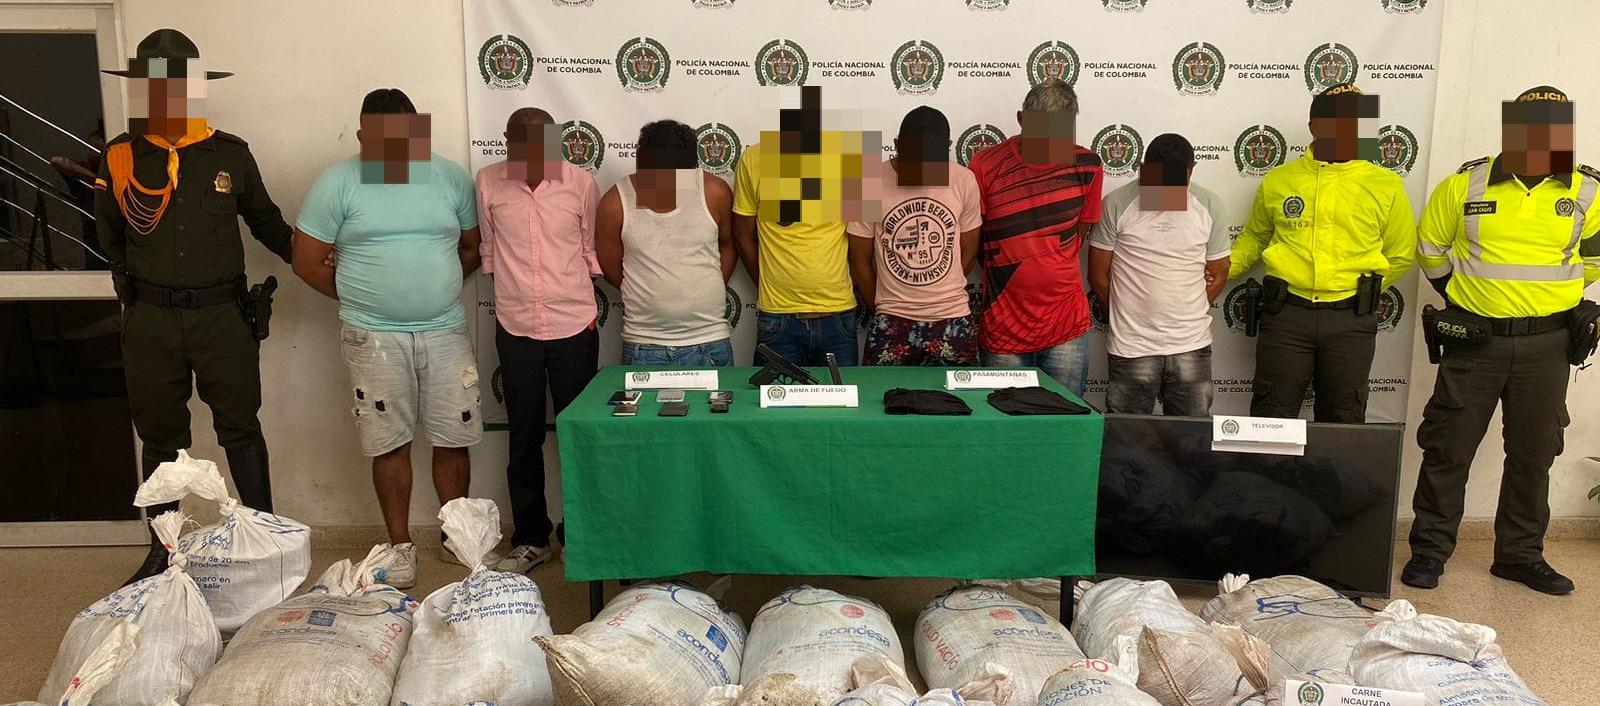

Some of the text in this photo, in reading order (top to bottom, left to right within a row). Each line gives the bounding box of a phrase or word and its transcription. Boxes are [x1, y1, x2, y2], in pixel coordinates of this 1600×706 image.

[536, 56, 612, 66] POLICÍA NACIONAL
[676, 59, 750, 68] POLICÍA NACIONAL
[812, 60, 886, 69] POLICÍA NACIONAL
[948, 61, 979, 69] POLICÍA
[1084, 61, 1157, 70] POLICÍA NACIONAL
[1228, 62, 1301, 71] POLICÍA NACIONAL
[1363, 62, 1392, 70] POLICÍA
[472, 140, 503, 148] POLICÍA
[885, 201, 954, 235] WORLDWIDE BERLIN
[676, 627, 731, 685] acondesa
[1351, 688, 1382, 698] CARNE
